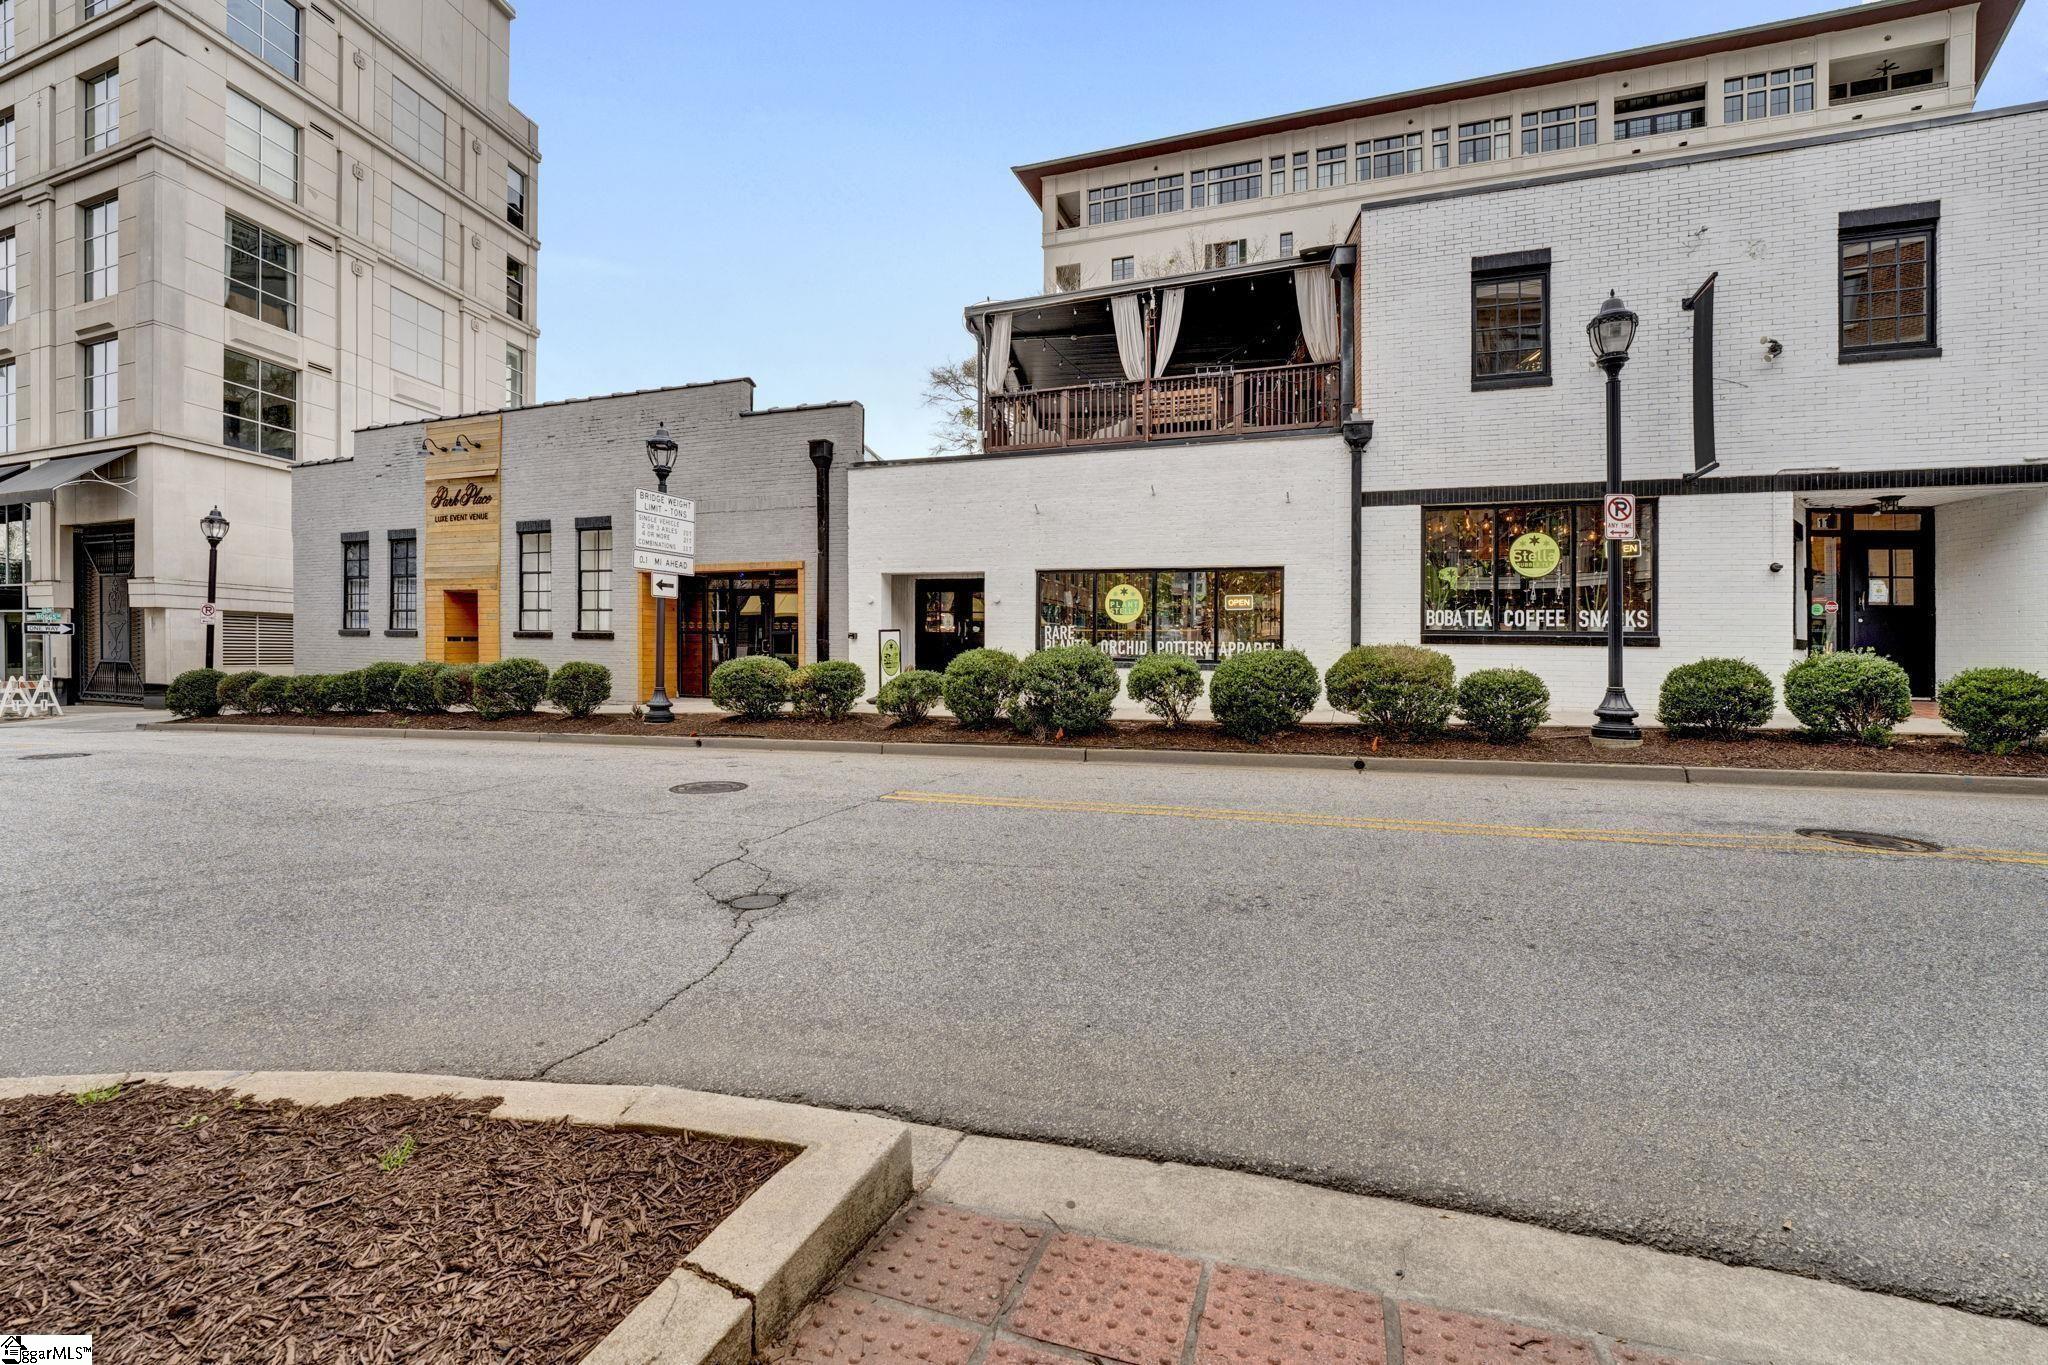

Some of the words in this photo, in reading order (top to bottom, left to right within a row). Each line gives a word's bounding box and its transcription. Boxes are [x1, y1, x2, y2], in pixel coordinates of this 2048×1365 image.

[430, 485, 461, 508] Park
[460, 482, 492, 506] Place
[640, 491, 665, 504] BRIDGE
[668, 497, 691, 509] WEIGHT
[434, 515, 449, 523] LUXE
[450, 513, 467, 522] EVENT
[469, 512, 489, 520] VENUE
[644, 502, 662, 513] LIMIT
[670, 507, 688, 519] TONS
[638, 538, 677, 550] COMBINATIONS
[639, 555, 648, 564] 0.1
[655, 557, 662, 566] MI
[666, 559, 688, 570] AHEAD
[1513, 549, 1556, 562] Stella
[1227, 598, 1251, 607] OPEN
[1426, 609, 1463, 627] BOBA
[1465, 609, 1493, 627] TEA
[1503, 609, 1566, 627] COFFEE
[1578, 609, 1649, 628] SNAKS
[1044, 625, 1075, 640] RARE
[1100, 640, 1147, 656] ORCHID
[1157, 640, 1211, 657] POTTERY
